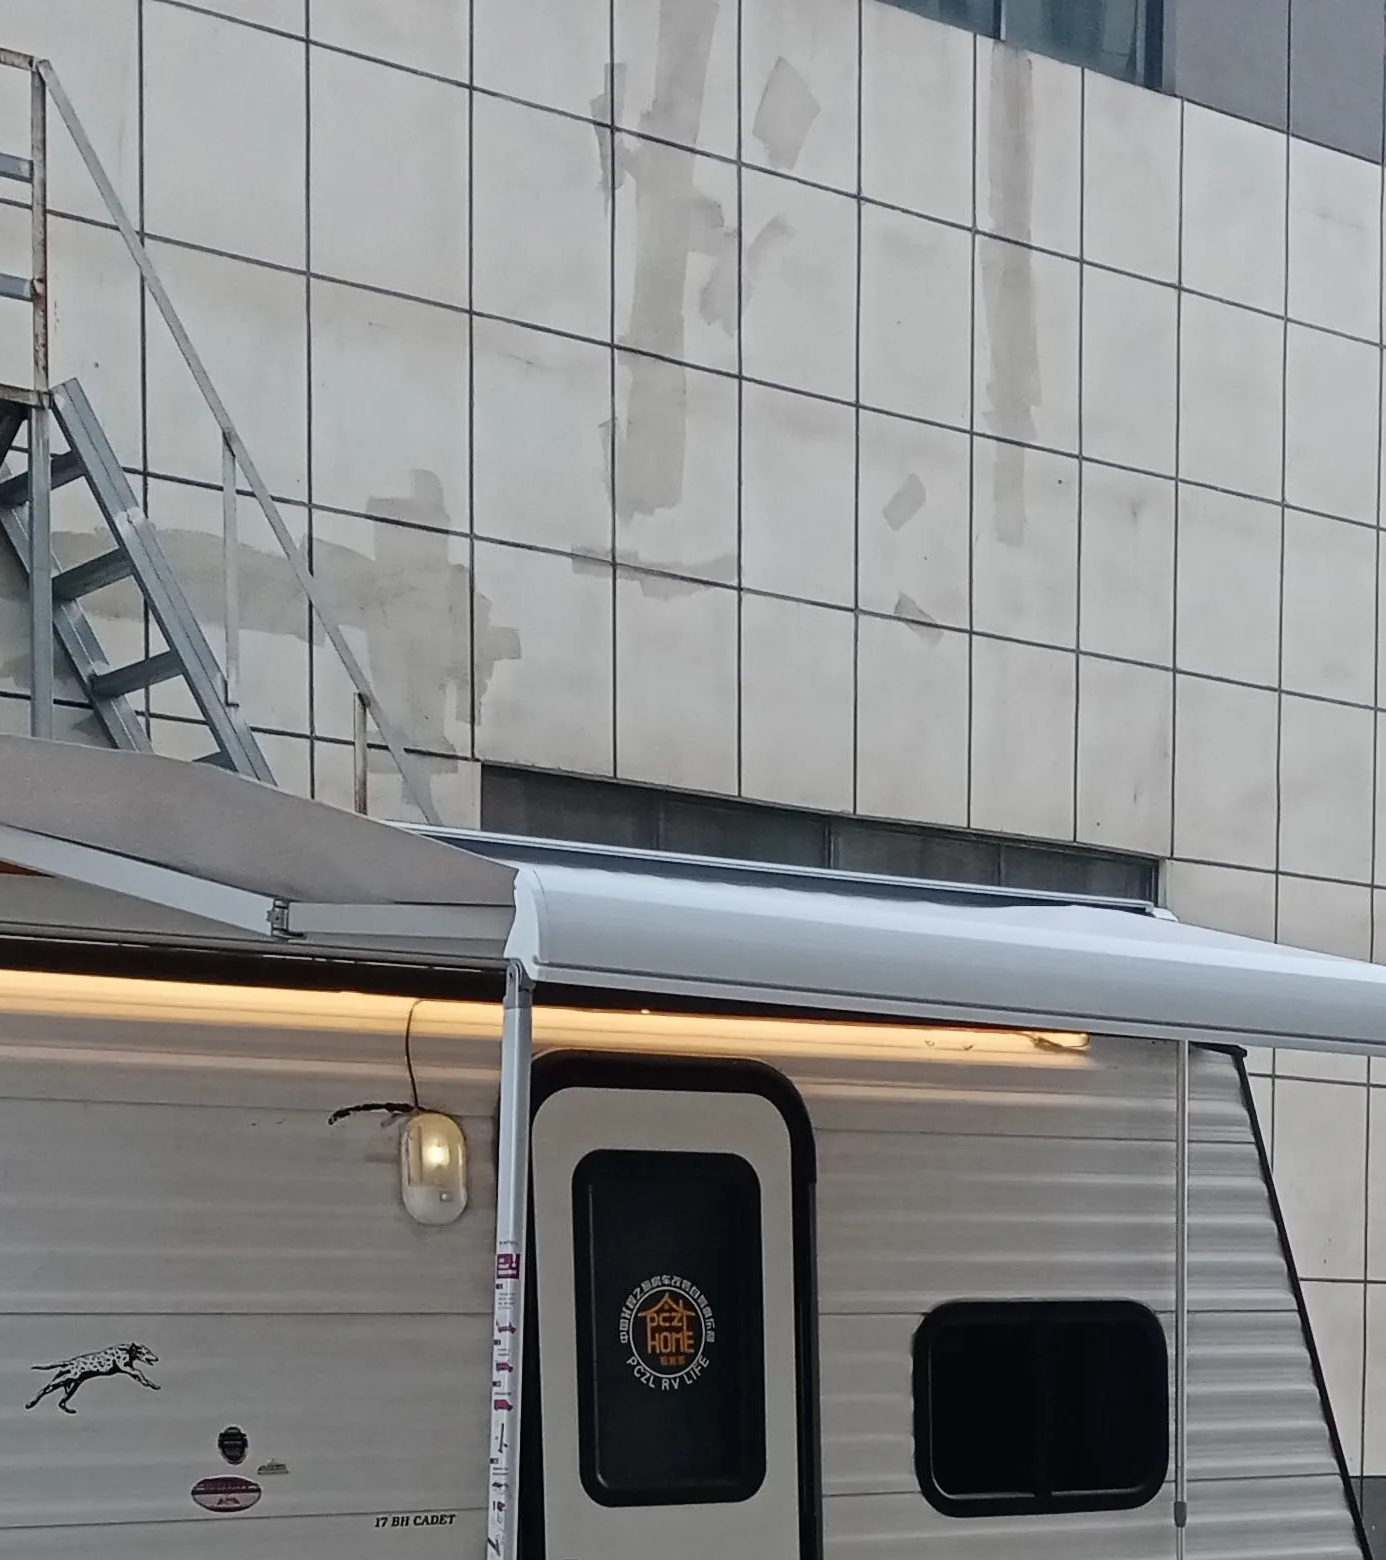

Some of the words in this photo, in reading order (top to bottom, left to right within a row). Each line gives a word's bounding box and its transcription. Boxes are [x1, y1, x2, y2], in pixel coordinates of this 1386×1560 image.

[647, 1331, 695, 1353] HOME
[626, 1356, 655, 1388] PCZL
[661, 1378, 681, 1391] RV
[683, 1355, 710, 1384] LIFE
[374, 1516, 389, 1528] 17
[391, 1515, 410, 1527] BH
[413, 1513, 457, 1526] CADET
